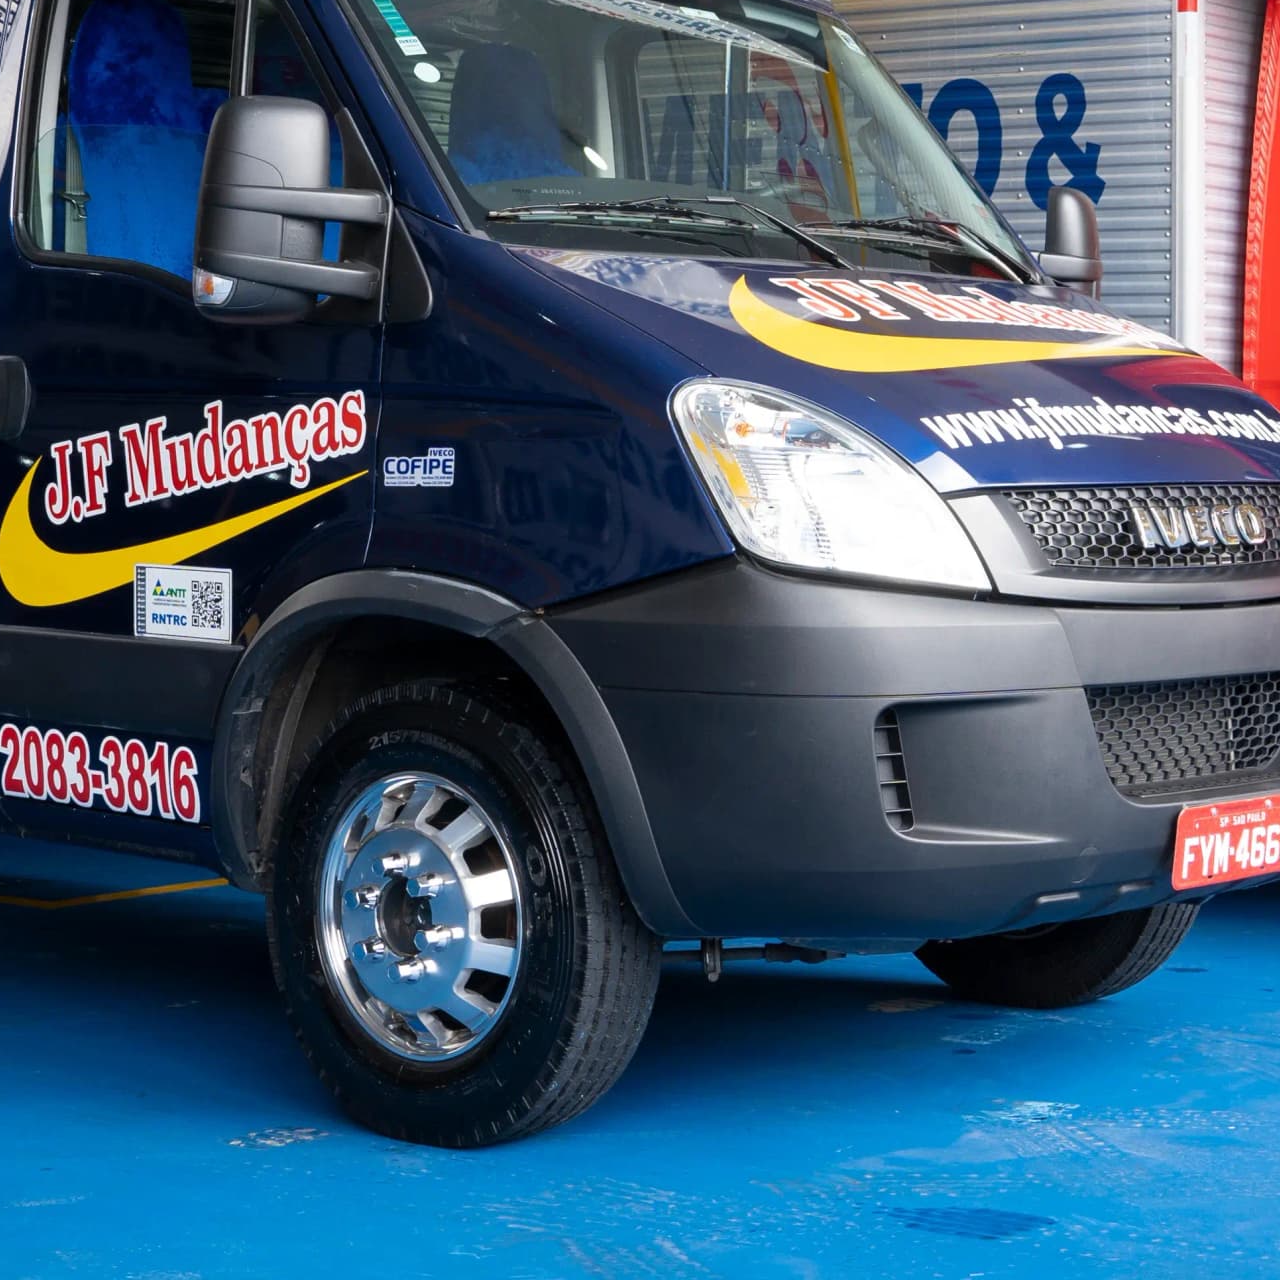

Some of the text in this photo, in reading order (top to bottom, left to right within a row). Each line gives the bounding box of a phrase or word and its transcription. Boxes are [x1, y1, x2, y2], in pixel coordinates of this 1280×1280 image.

[1025, 73, 1107, 211] &
[120, 389, 367, 508] Mudanças
[429, 448, 454, 457] IVECO
[384, 458, 454, 475] COFIPE
[1131, 502, 1267, 551] IVECO
[166, 587, 187, 599] ANTT
[151, 612, 188, 627] RNTRC
